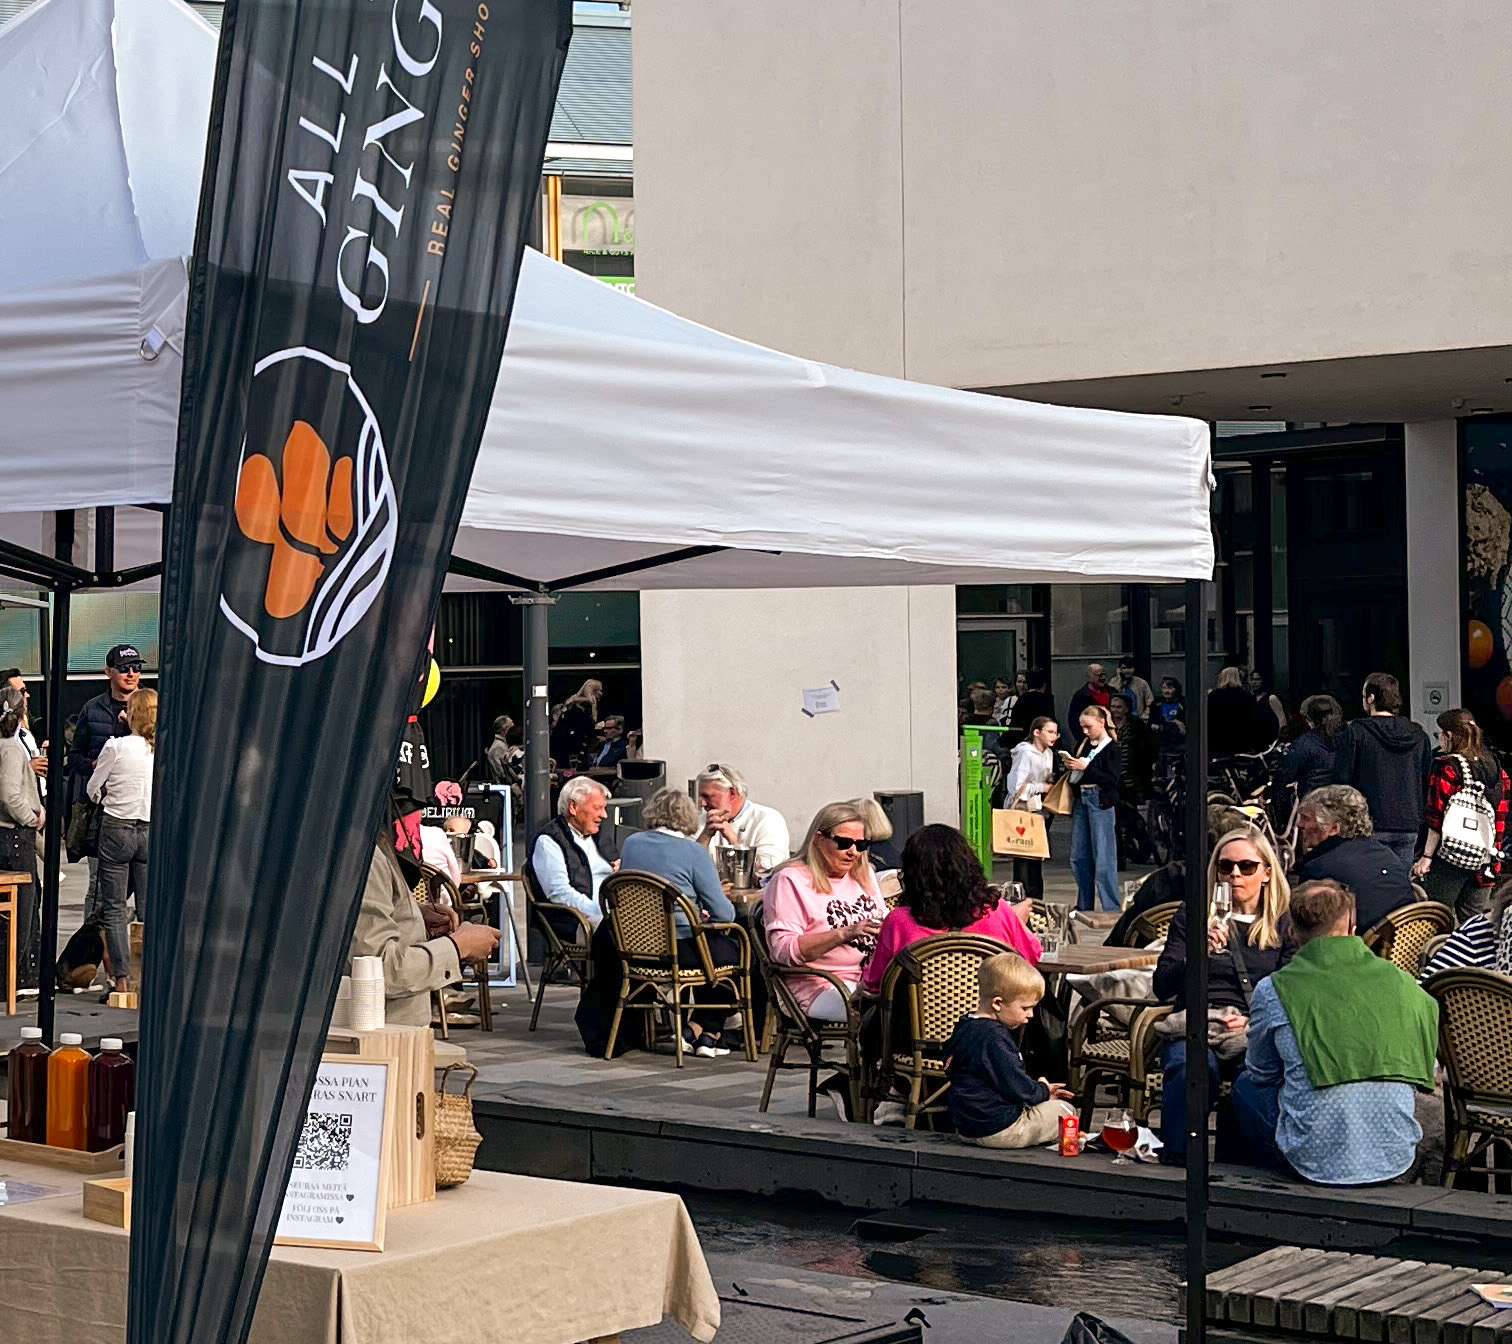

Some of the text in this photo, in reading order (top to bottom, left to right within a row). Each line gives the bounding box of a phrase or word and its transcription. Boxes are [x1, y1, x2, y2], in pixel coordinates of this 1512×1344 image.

[288, 54, 358, 229] ALL
[428, 188, 455, 256] REAL
[448, 67, 476, 172] GINGER
[342, 1076, 369, 1088] PIAN
[338, 1090, 377, 1102] SNART
[290, 1182, 320, 1190] SEURAA
